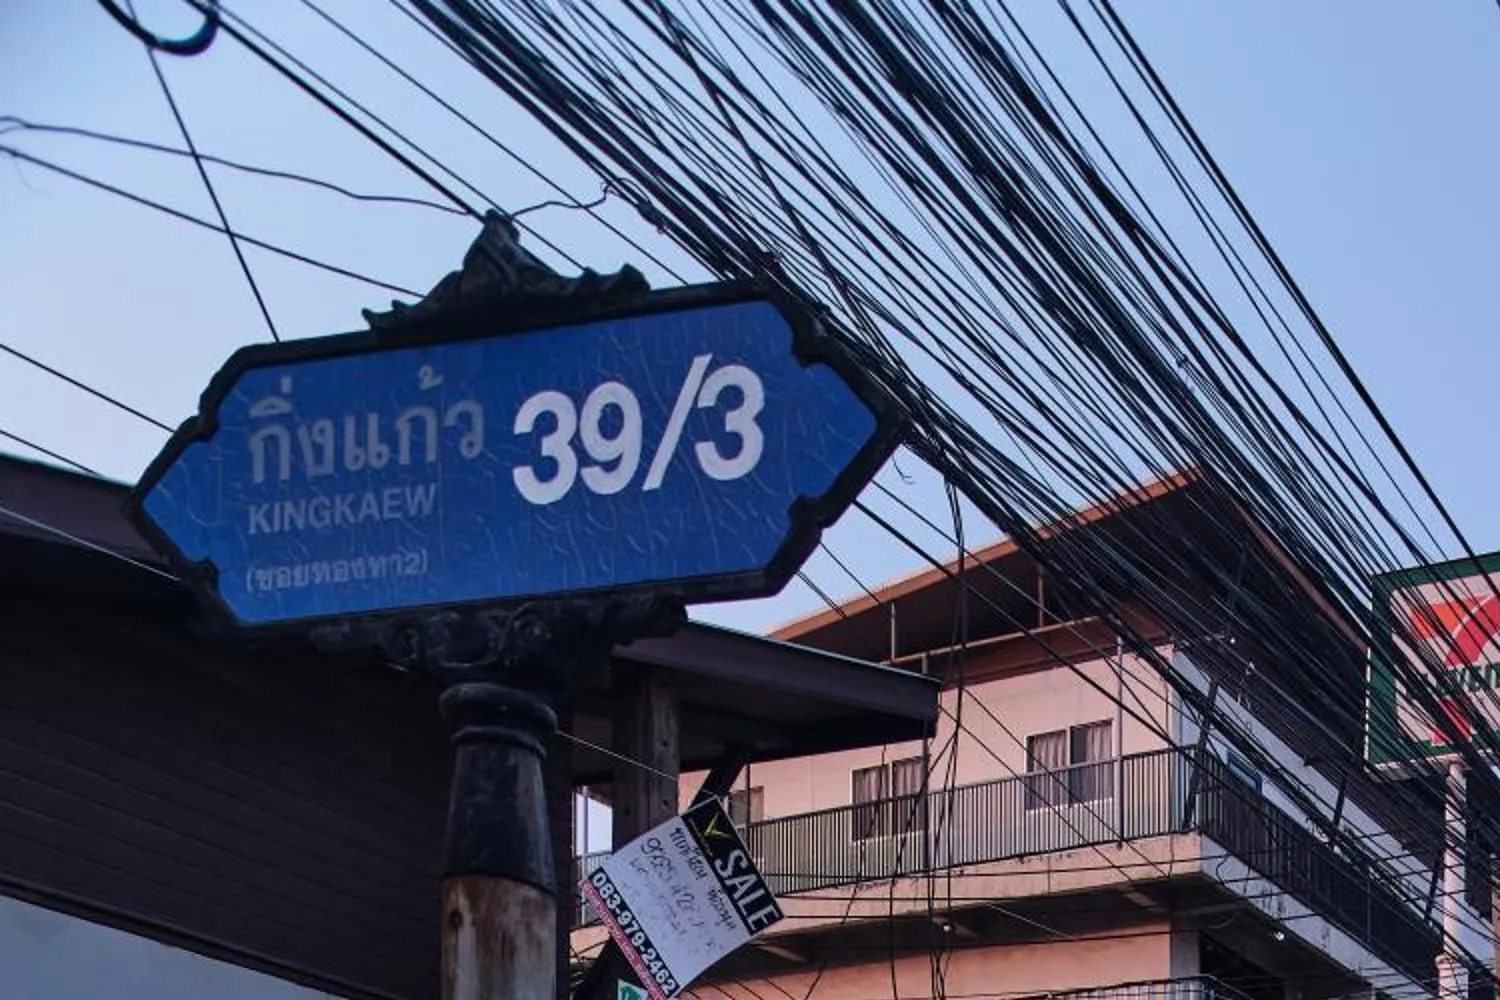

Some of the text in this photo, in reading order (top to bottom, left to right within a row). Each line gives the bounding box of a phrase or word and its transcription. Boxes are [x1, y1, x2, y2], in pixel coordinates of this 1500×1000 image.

[247, 352, 765, 505] กิ่งแก้ว 39/3
[248, 484, 436, 535] KINGKAEW
[592, 872, 677, 995] 083-979-2462
[714, 848, 779, 935] SALE
